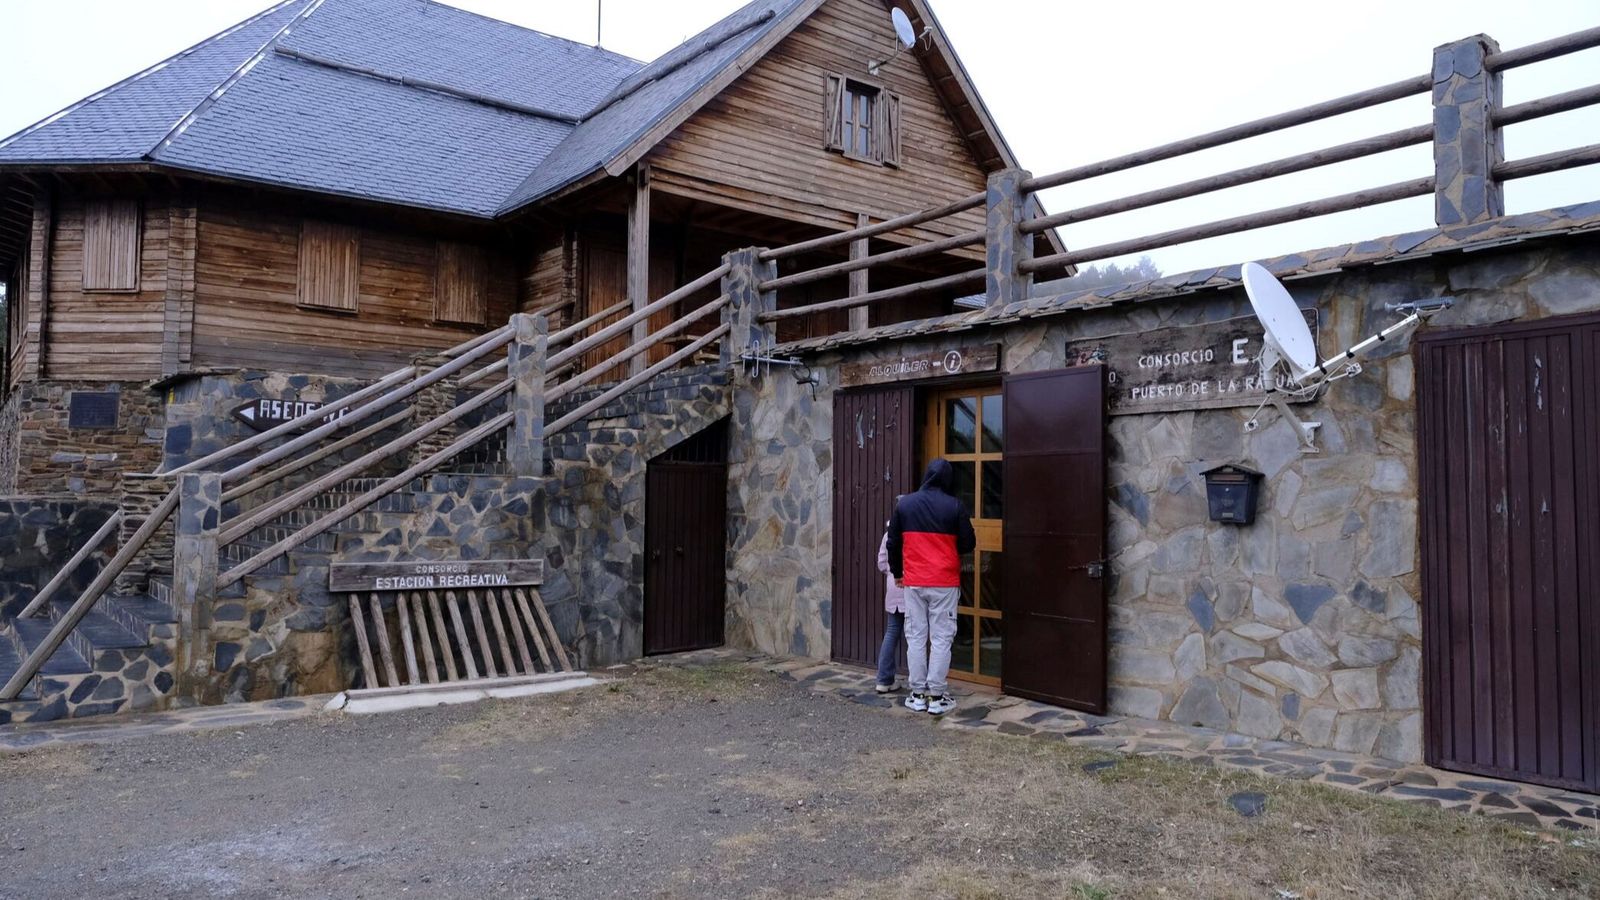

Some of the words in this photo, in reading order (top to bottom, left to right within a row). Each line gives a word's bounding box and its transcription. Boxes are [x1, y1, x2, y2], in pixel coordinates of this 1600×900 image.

[1191, 380, 1209, 395] DE
[1218, 379, 1236, 393] LA
[1245, 374, 1295, 391] RAUA
[415, 564, 468, 574] CONSORCIO
[375, 576, 434, 589] ESTACION
[439, 573, 508, 587] RECREATIVA
